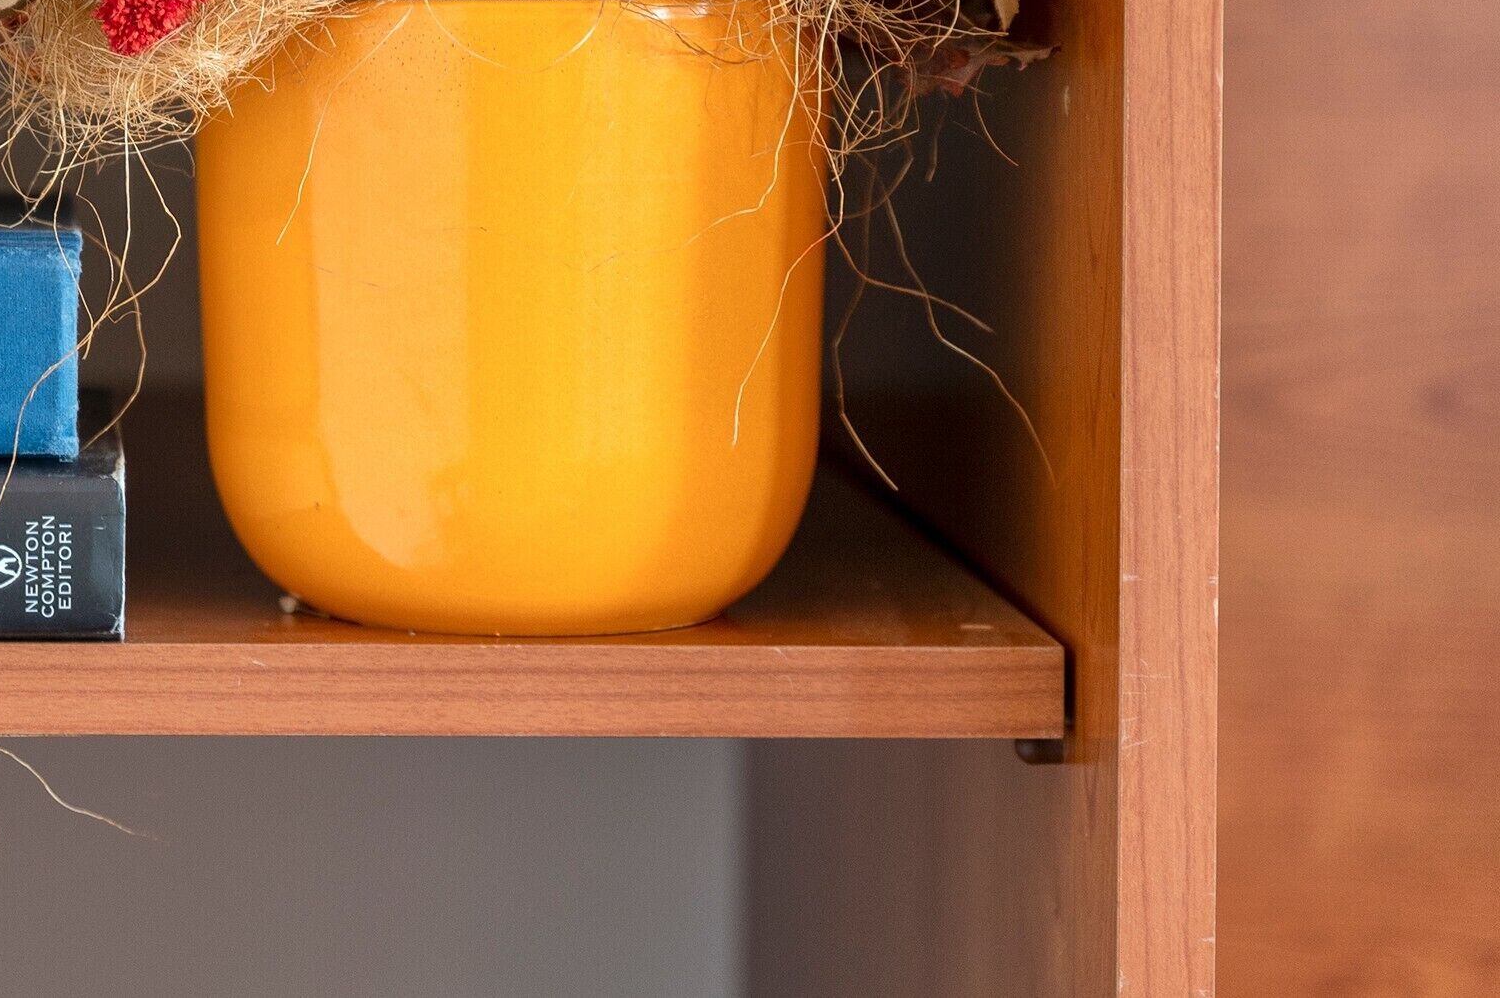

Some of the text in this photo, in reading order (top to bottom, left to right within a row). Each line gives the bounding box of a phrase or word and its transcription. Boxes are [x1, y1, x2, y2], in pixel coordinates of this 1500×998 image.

[25, 521, 39, 613] NEWTON
[41, 515, 56, 618] COMPTON
[58, 523, 73, 610] EDITORI
